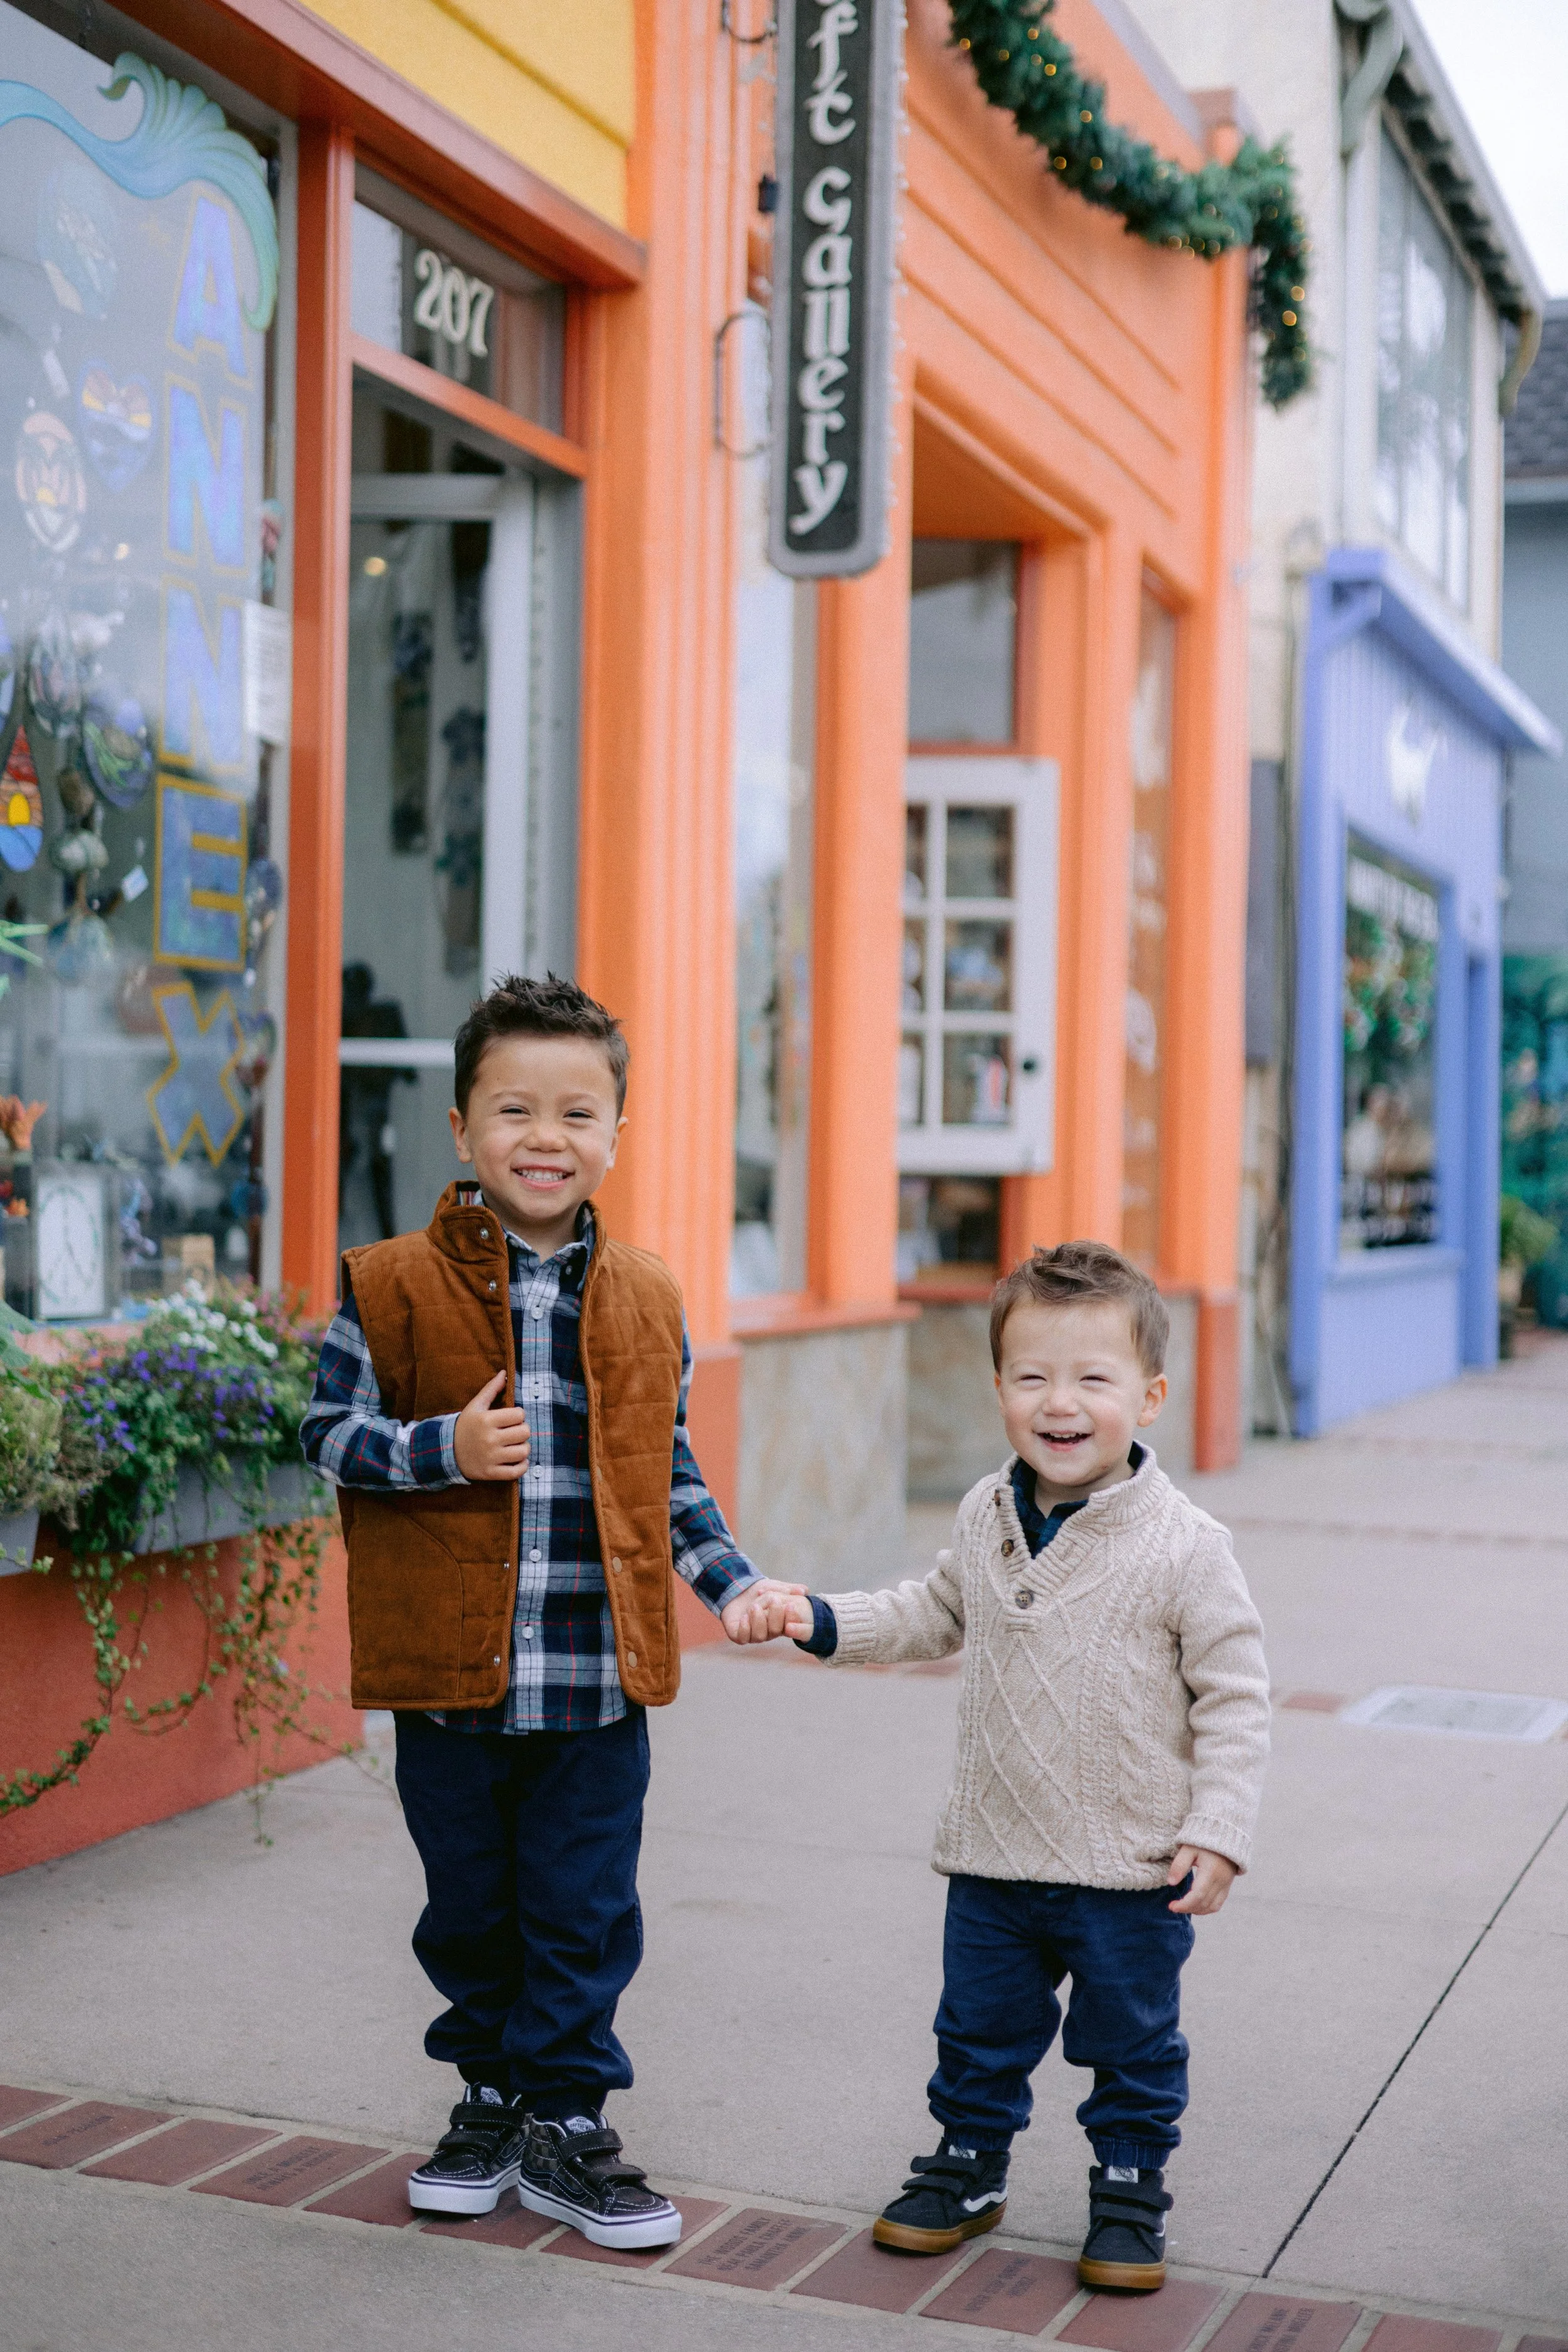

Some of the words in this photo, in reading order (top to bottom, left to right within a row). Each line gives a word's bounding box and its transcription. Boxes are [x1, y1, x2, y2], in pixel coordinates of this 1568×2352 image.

[803, 0, 859, 145] ft
[414, 249, 494, 358] 207
[147, 188, 253, 1167] ANNEX
[697, 2255, 721, 2265] THE
[714, 2235, 748, 2255] WOODS
[739, 2217, 771, 2235] FAMILY
[745, 2243, 789, 2271] SAMANTHA
